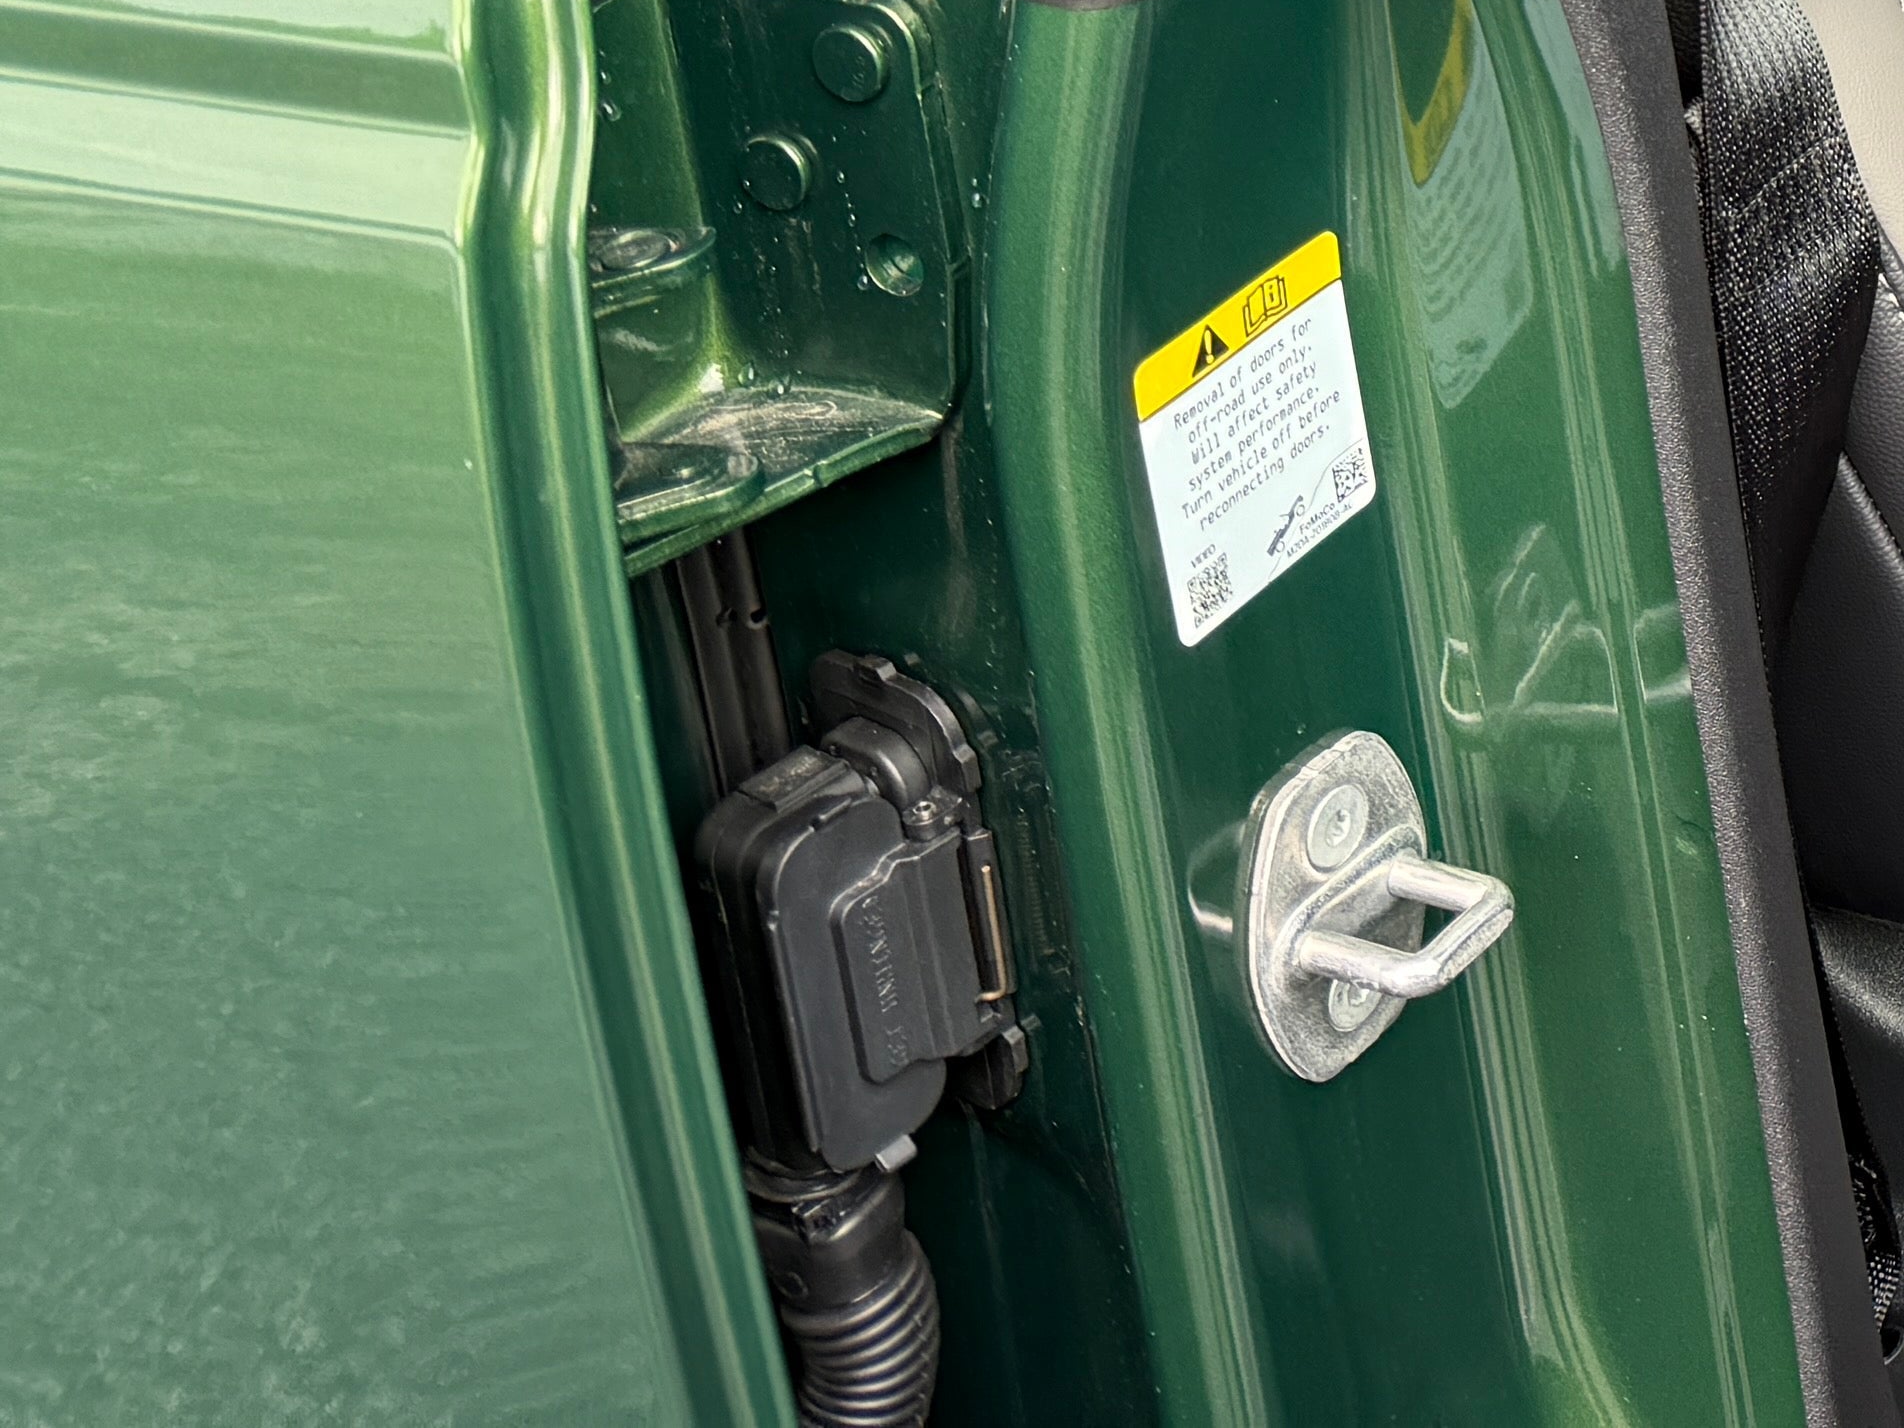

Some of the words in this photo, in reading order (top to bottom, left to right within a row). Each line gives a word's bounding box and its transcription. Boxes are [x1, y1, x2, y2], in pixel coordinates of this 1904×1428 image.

[1173, 383, 1224, 431] Removal
[1229, 366, 1243, 389] of
[1249, 338, 1285, 373] doors
[1291, 318, 1311, 342] for
[1188, 389, 1246, 444] off-road
[1252, 371, 1272, 395] use
[1279, 346, 1312, 375] only.
[1191, 432, 1220, 465] Will
[1228, 396, 1270, 438] affect
[1276, 361, 1317, 401] safety
[1181, 489, 1212, 519] Turn
[1218, 447, 1268, 493] vehicle
[1272, 423, 1291, 450] off
[1299, 390, 1340, 431] before
[1188, 450, 1233, 492] system
[1238, 386, 1320, 457] performance.
[1200, 457, 1285, 531] reconnecting
[1290, 424, 1330, 460] doors.
